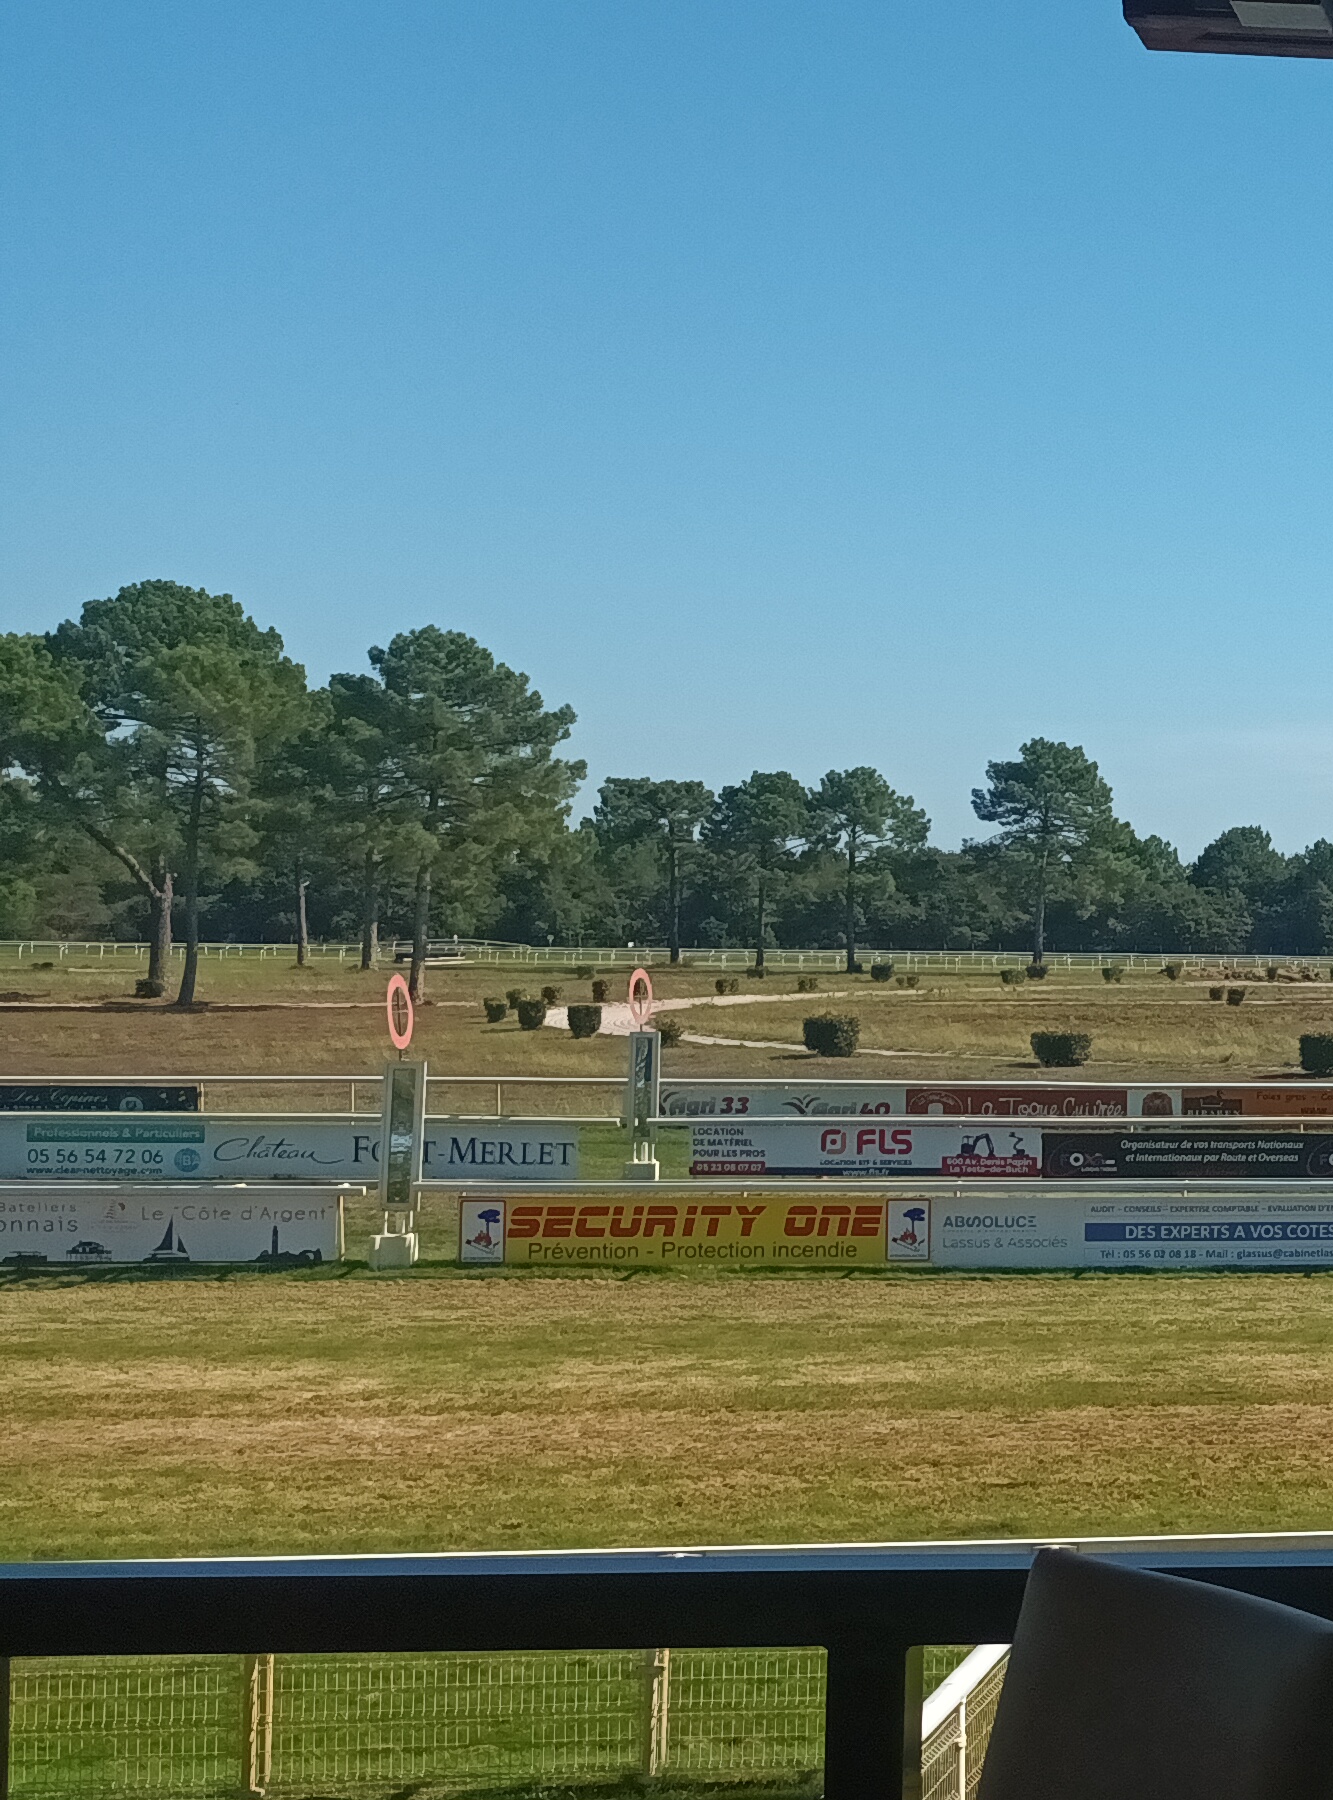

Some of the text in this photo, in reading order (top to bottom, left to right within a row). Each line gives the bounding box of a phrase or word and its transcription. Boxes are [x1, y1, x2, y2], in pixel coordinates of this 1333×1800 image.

[719, 1097, 750, 1115] 33
[34, 1127, 200, 1138] Professionnels & Particuliers
[692, 1128, 744, 1136] LOCATION
[692, 1138, 705, 1146] DE
[857, 1129, 912, 1155] FLS
[1121, 1139, 1304, 1151] Organisateur de vos transports Nationaux
[28, 1149, 49, 1164] 05
[56, 1149, 78, 1164] 56
[84, 1149, 106, 1164] 54
[113, 1149, 135, 1164] 72
[142, 1149, 163, 1164] 06
[213, 1135, 344, 1164] Château
[352, 1136, 575, 1166] FT-MERLET
[692, 1149, 720, 1157] POUR
[739, 1149, 766, 1157] PROS
[1126, 1153, 1299, 1164] et Internationaux par Route et Overseas
[141, 1206, 164, 1221] Le
[1268, 1204, 1316, 1212] EVALUATION
[507, 1205, 885, 1238] SECURITY ONE
[943, 1216, 1037, 1228] ABSOLUCE
[1125, 1226, 1156, 1239] DES
[1161, 1225, 1230, 1239] EXPERTS
[1233, 1225, 1246, 1238] A
[1250, 1225, 1283, 1238] VOS
[942, 1236, 1068, 1248] Lassus & Associés
[527, 1241, 858, 1260] Prévention Protection incendie
[1123, 1250, 1135, 1258] 05
[1139, 1250, 1151, 1258] 56
[1169, 1250, 1181, 1258] 08
[1185, 1250, 1196, 1258] 18
[1206, 1249, 1228, 1258] Mail
